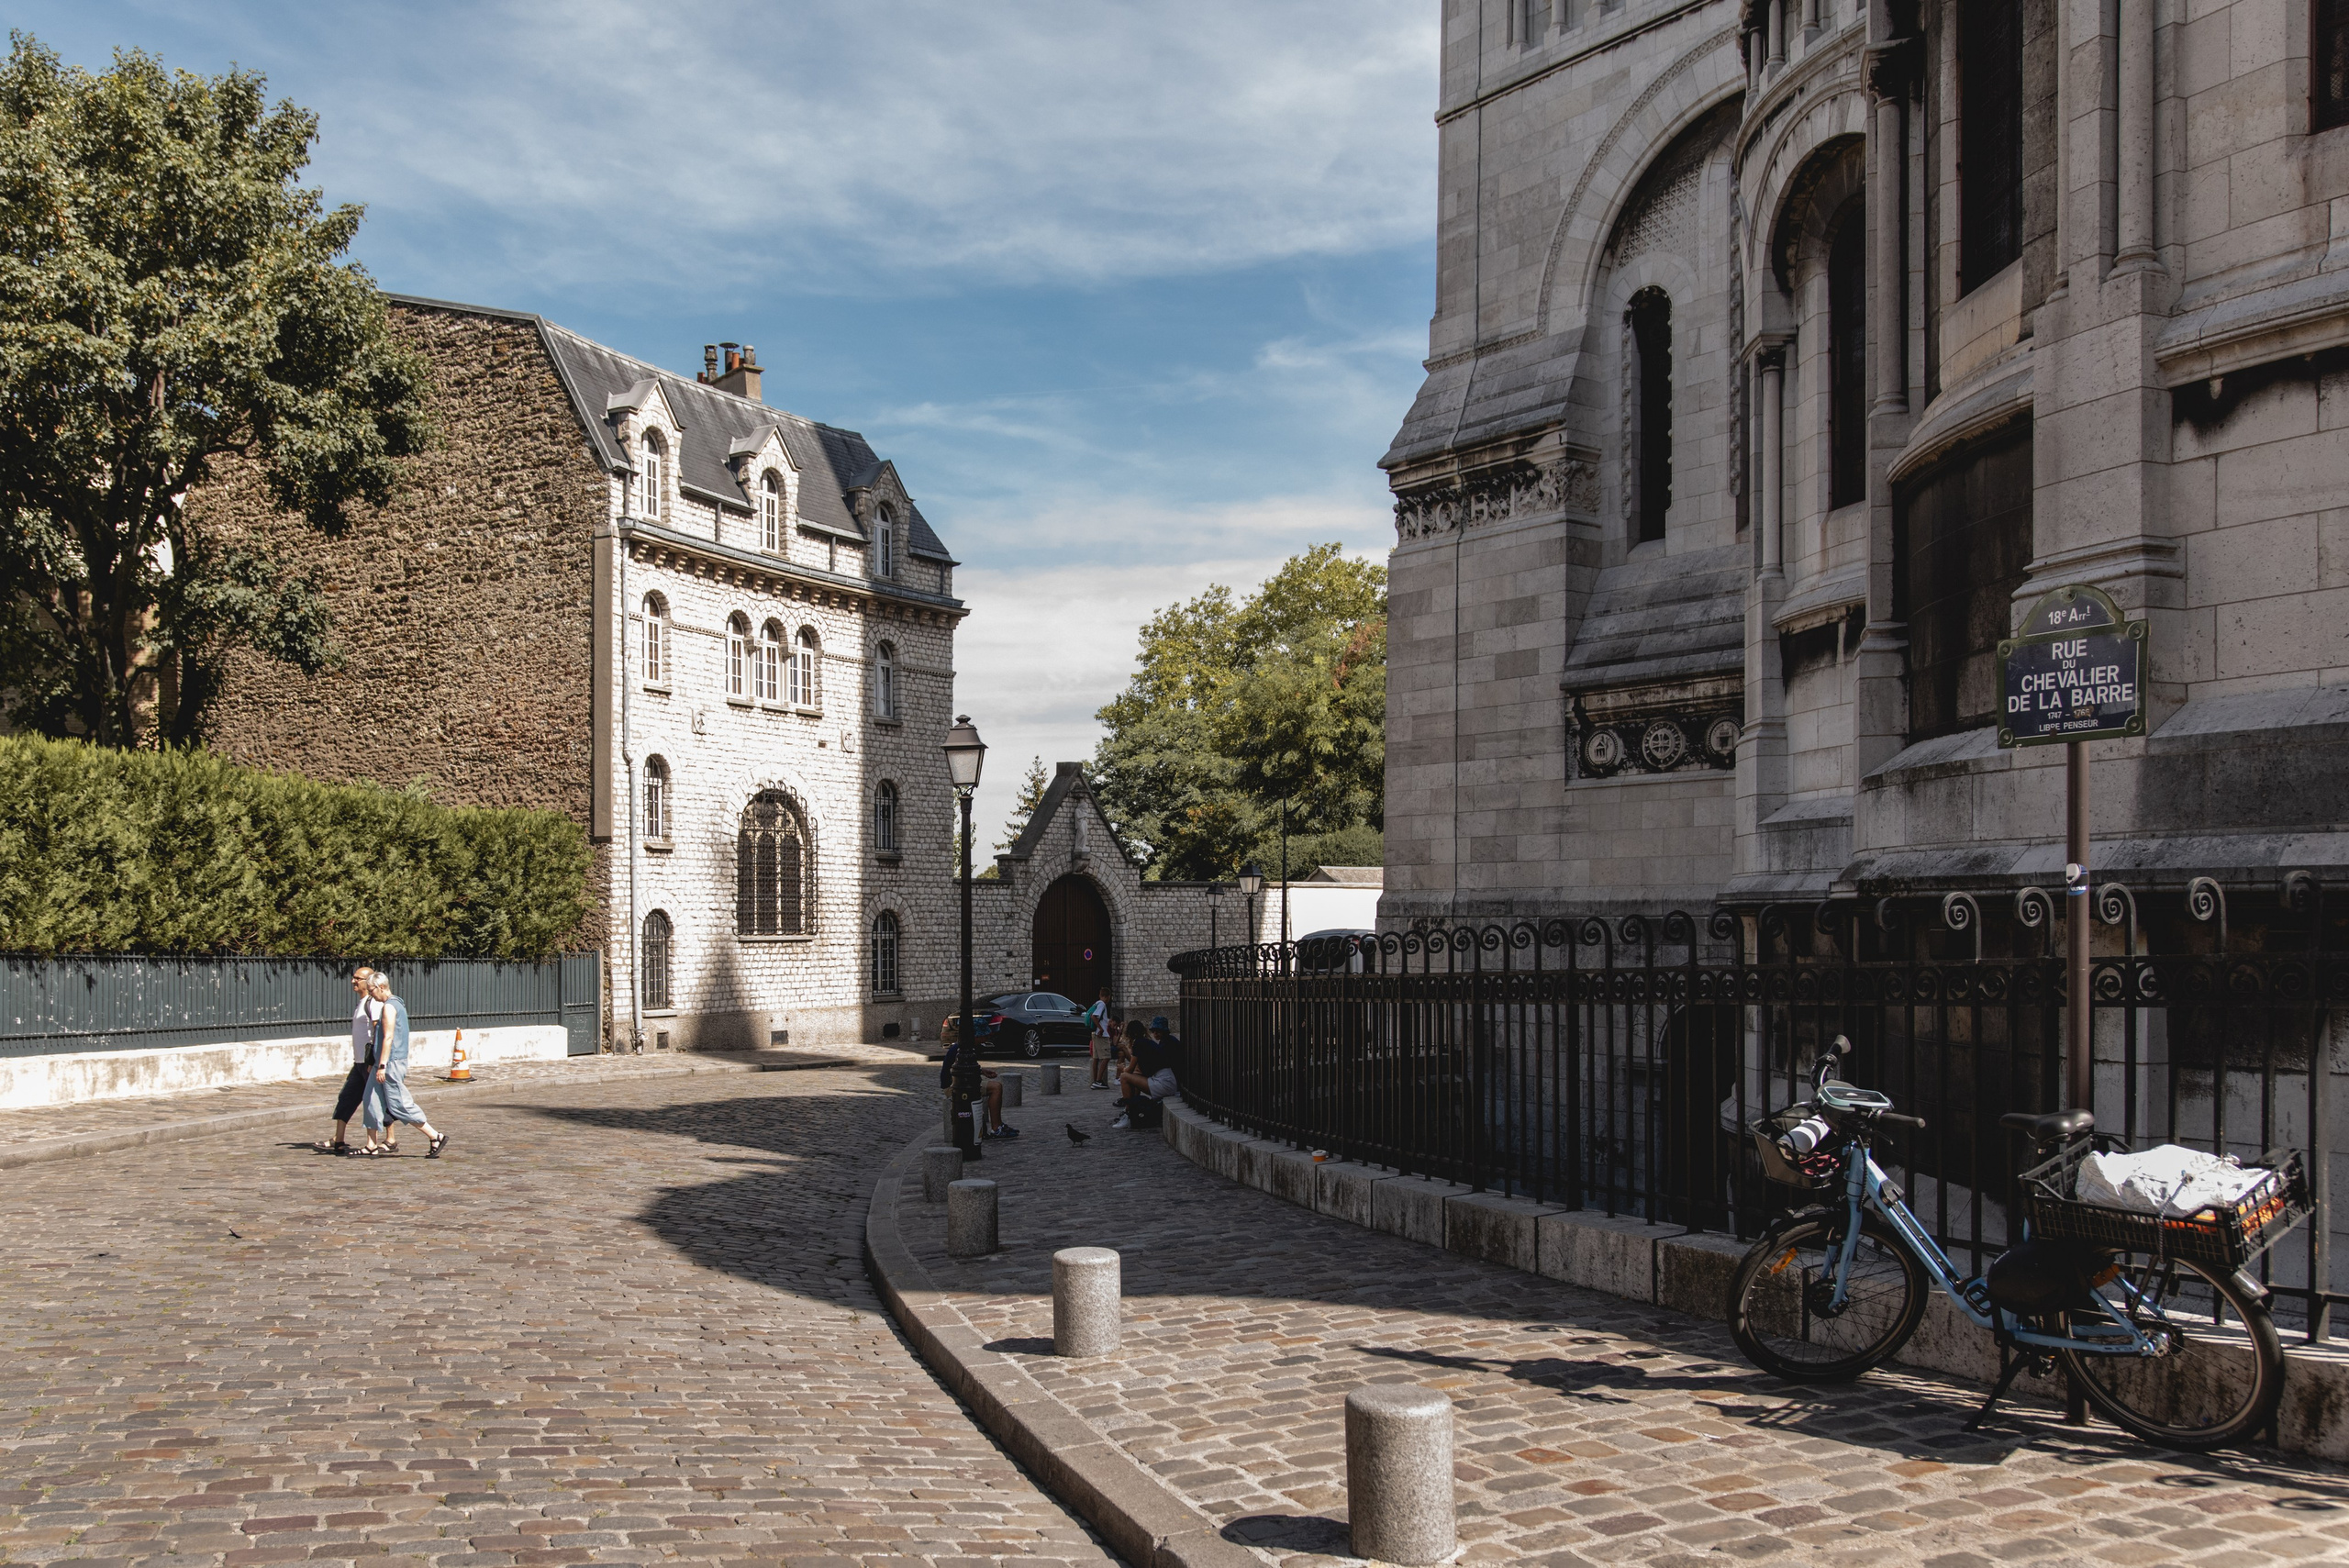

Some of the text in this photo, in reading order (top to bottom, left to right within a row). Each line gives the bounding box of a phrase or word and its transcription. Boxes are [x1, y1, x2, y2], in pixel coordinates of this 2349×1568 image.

[1404, 473, 1558, 540] NOBIS
[2048, 605, 2091, 625] 18e Arrt
[2052, 639, 2087, 660] RUE
[2062, 659, 2076, 670] DU
[2021, 664, 2120, 693] CHEVALIER
[2008, 683, 2133, 713] DE LA BARRE
[2047, 710, 2063, 720] 1747
[2063, 718, 2099, 730] PENSEUR
